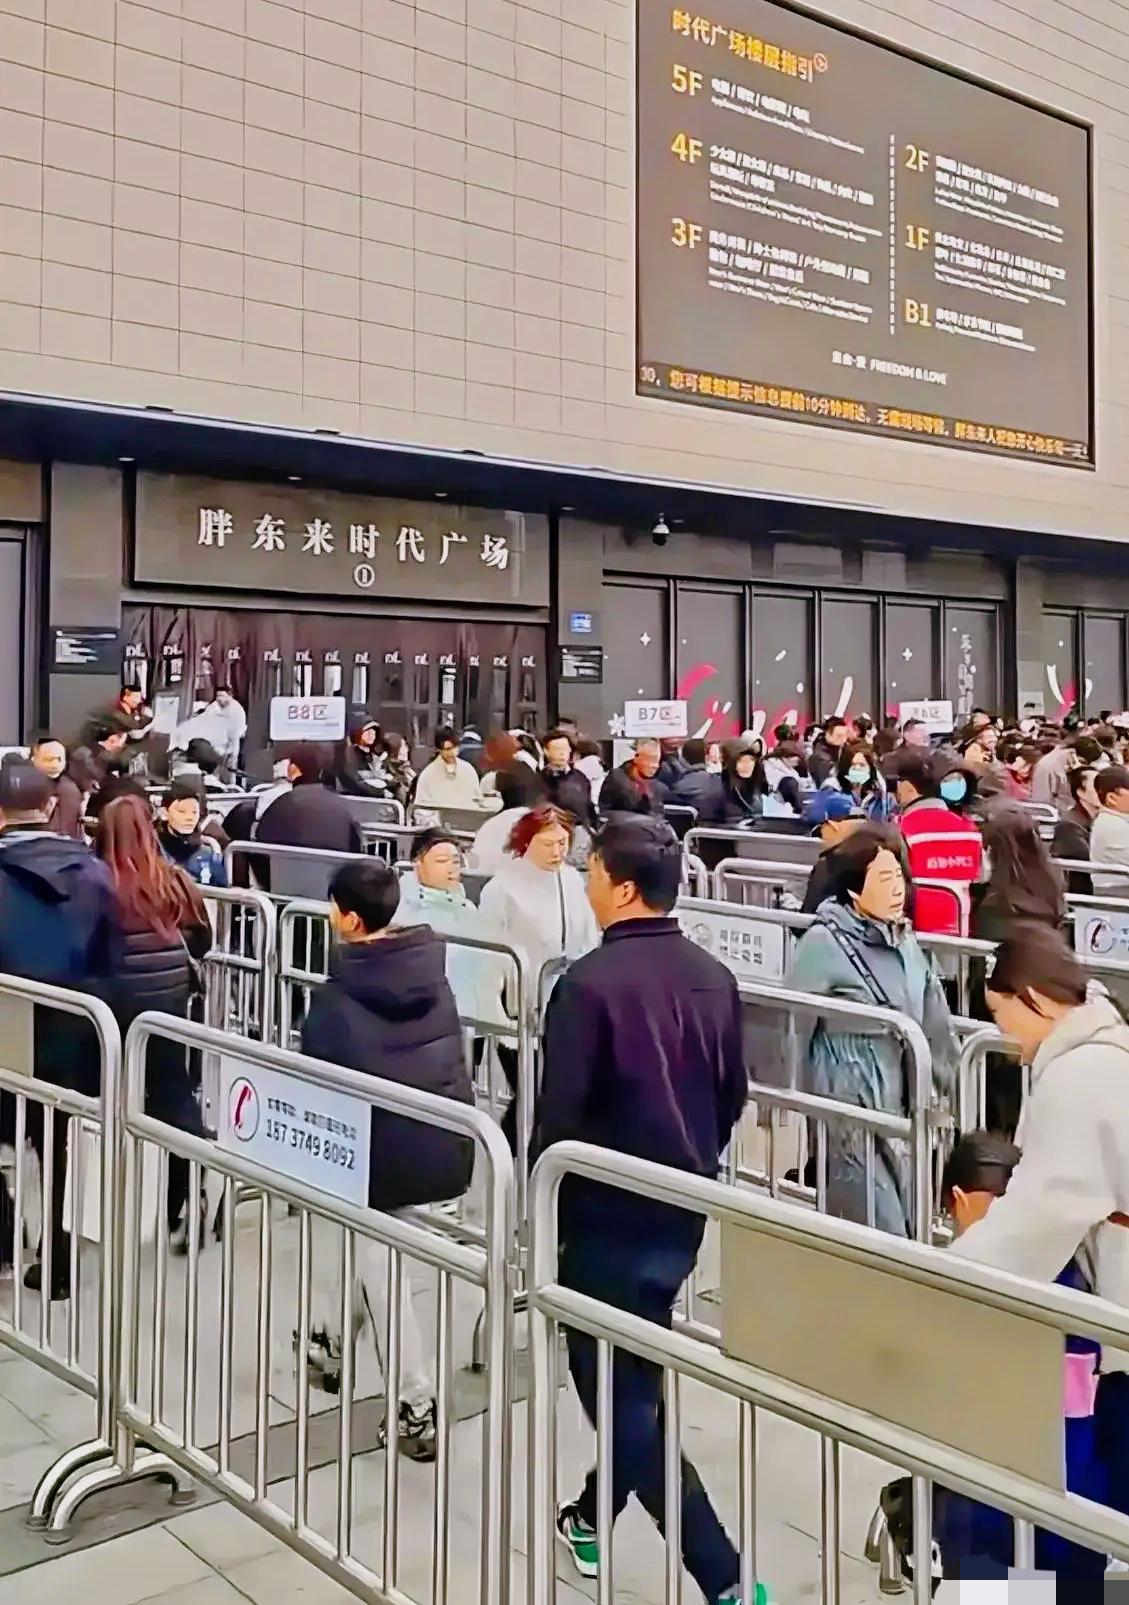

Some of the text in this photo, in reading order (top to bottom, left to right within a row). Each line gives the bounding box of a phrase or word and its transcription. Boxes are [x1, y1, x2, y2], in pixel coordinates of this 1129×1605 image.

[671, 64, 703, 96] 5F
[671, 132, 703, 164] 4F
[905, 144, 930, 172] 2F
[671, 217, 703, 249] 3F
[905, 224, 930, 251] 1F
[905, 298, 932, 327] B1
[197, 507, 510, 570] 胖东来时代广场
[288, 704, 329, 720] B8区
[266, 1118, 288, 1143] 157
[290, 1128, 321, 1156] 3749
[323, 1139, 355, 1170] 8092
